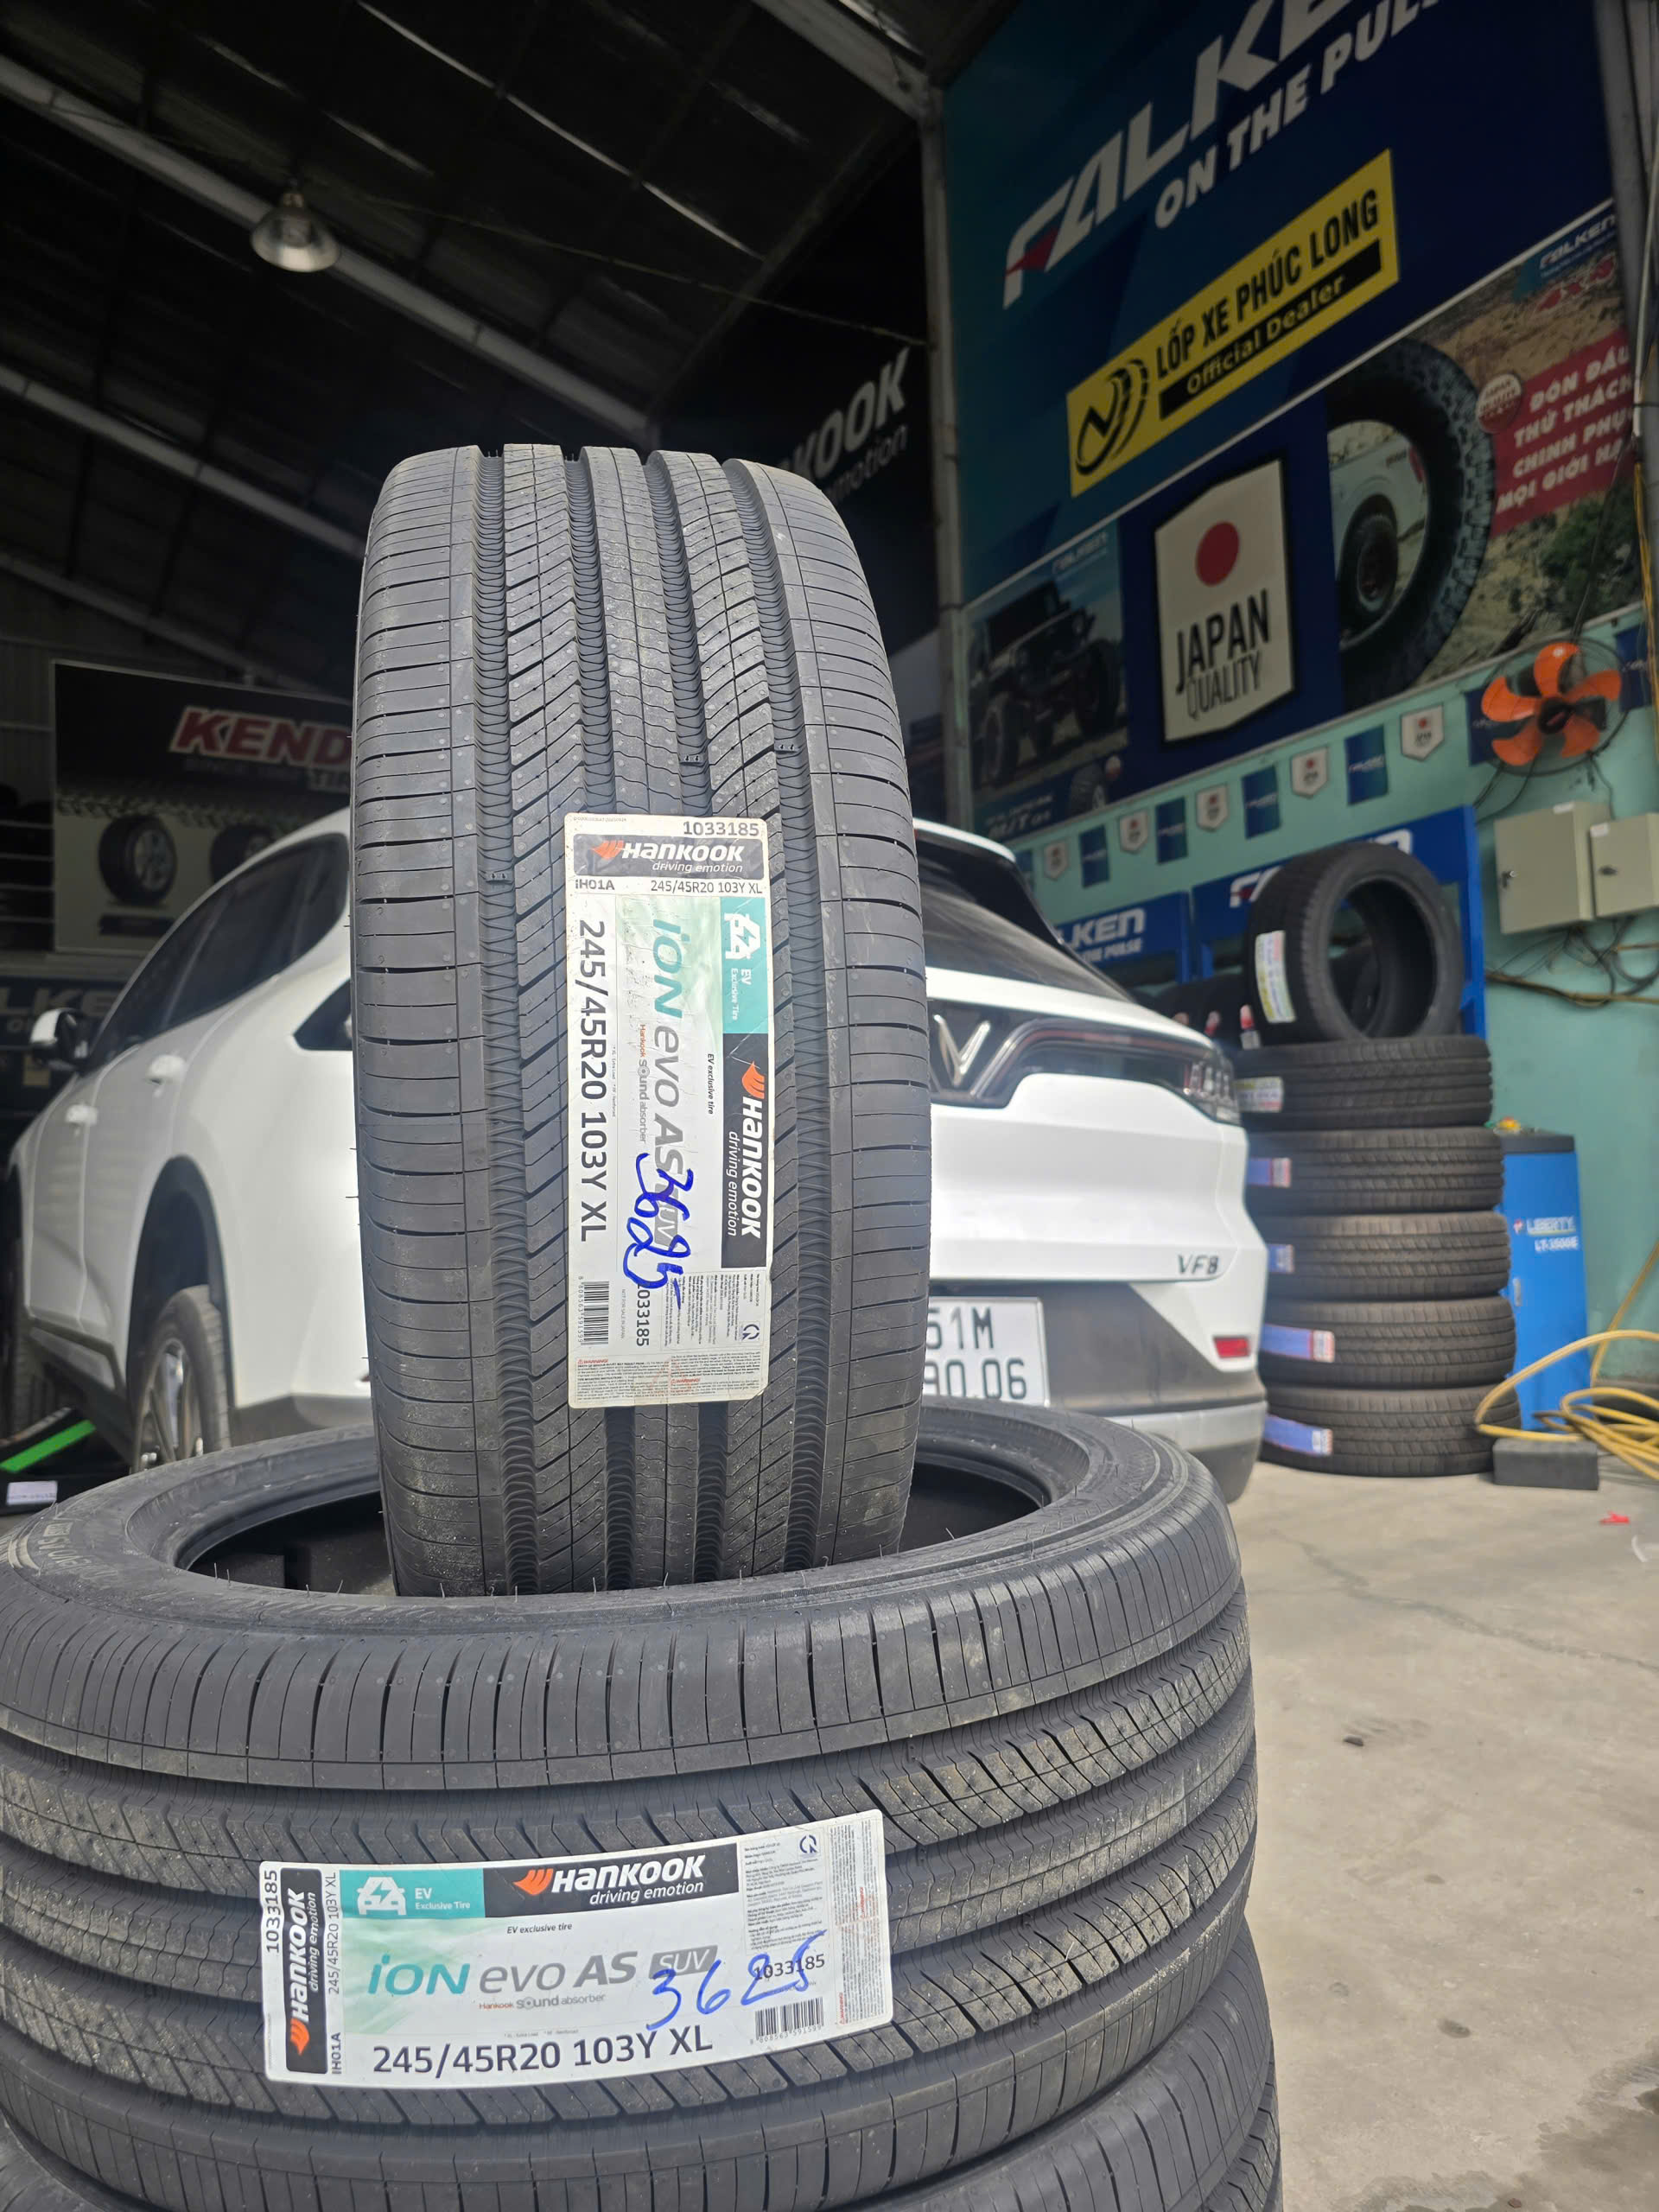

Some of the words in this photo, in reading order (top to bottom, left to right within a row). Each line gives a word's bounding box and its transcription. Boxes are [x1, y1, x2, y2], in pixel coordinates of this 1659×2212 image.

[1155, 145, 1217, 228] ON
[1227, 63, 1312, 172] THE
[1320, 0, 1436, 95] PUL
[1155, 317, 1195, 378] LỐP
[1200, 298, 1229, 346] XE
[1235, 245, 1302, 322] PHÚC
[1309, 188, 1378, 269] LONG
[1186, 329, 1262, 395] Official
[1266, 275, 1346, 342] Dealer
[779, 346, 911, 480] KOOK
[1176, 588, 1268, 695] JAPAN
[1186, 650, 1261, 721] QUALITY
[167, 705, 352, 769] KEND
[683, 821, 760, 836] 1033185
[650, 880, 715, 893] 245/45R20
[718, 881, 746, 893] 103Y
[748, 882, 763, 894] XL
[652, 861, 692, 874] driving
[695, 862, 743, 874] emotion
[730, 968, 739, 1002] Exclusive
[741, 969, 752, 985] EV
[575, 919, 609, 1101] 245/45R20
[639, 1024, 647, 1058] Hankook
[707, 1053, 715, 1066] EV
[638, 1059, 650, 1101] sound
[654, 1025, 680, 1108] evo
[639, 1102, 648, 1144] absorber
[654, 1113, 685, 1174] AS
[581, 1112, 607, 1191] 103Y
[728, 1130, 738, 1179] driving
[581, 1200, 607, 1242] XL
[728, 1182, 737, 1236] emotion
[637, 1283, 651, 1346] 033185
[325, 1872, 337, 1888] XL
[415, 1888, 433, 1899] EV
[589, 1888, 640, 1906] driving
[644, 1880, 705, 1900] emotion
[264, 1869, 279, 1954] 1033185
[308, 1891, 318, 1944] emotion
[327, 1891, 339, 1922] 103Y
[415, 1902, 452, 1910] Exclusive
[454, 1900, 471, 1910] Tire
[519, 1923, 556, 1934] exclusive
[557, 1923, 573, 1931] tire
[309, 1945, 321, 1992] driving
[327, 1923, 340, 1995] 245/45R20
[367, 1955, 471, 1995] iON
[479, 1961, 566, 1995] evo
[573, 1950, 638, 1988] AS
[658, 1947, 714, 1977] SUV
[753, 1953, 826, 1981] 1033185
[479, 2002, 513, 2011] Hankook
[516, 1995, 559, 2010] sound
[561, 1993, 607, 2005] absorber
[372, 2041, 562, 2079] 245/45R20
[574, 2031, 658, 2066] 103Y
[669, 2024, 714, 2056] XL
